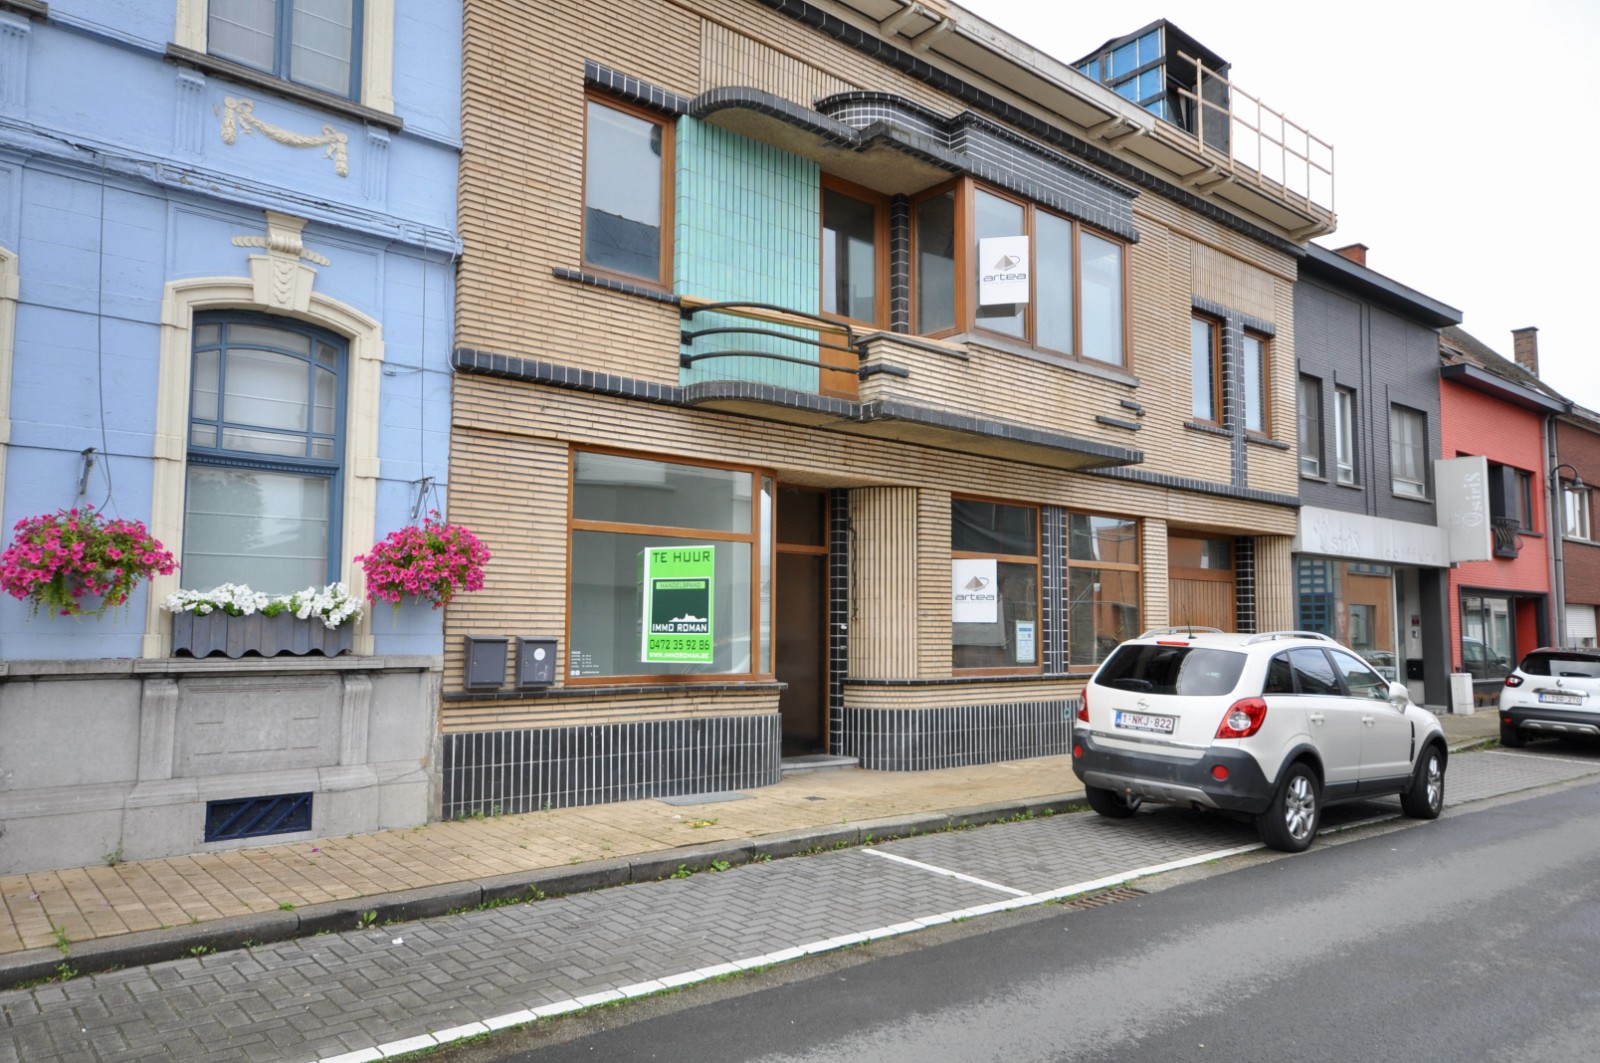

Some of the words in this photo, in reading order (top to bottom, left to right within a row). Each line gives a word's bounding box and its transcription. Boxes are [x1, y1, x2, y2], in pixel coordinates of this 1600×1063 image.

[983, 273, 1027, 282] artea
[652, 552, 668, 563] TE
[673, 551, 710, 562] HUUR
[954, 593, 995, 601] artea
[652, 624, 675, 632] IMMO
[677, 624, 707, 632] ROMAN
[650, 639, 671, 650] 0472
[673, 639, 684, 650] 35
[686, 639, 697, 650] 92
[699, 639, 710, 651] 86
